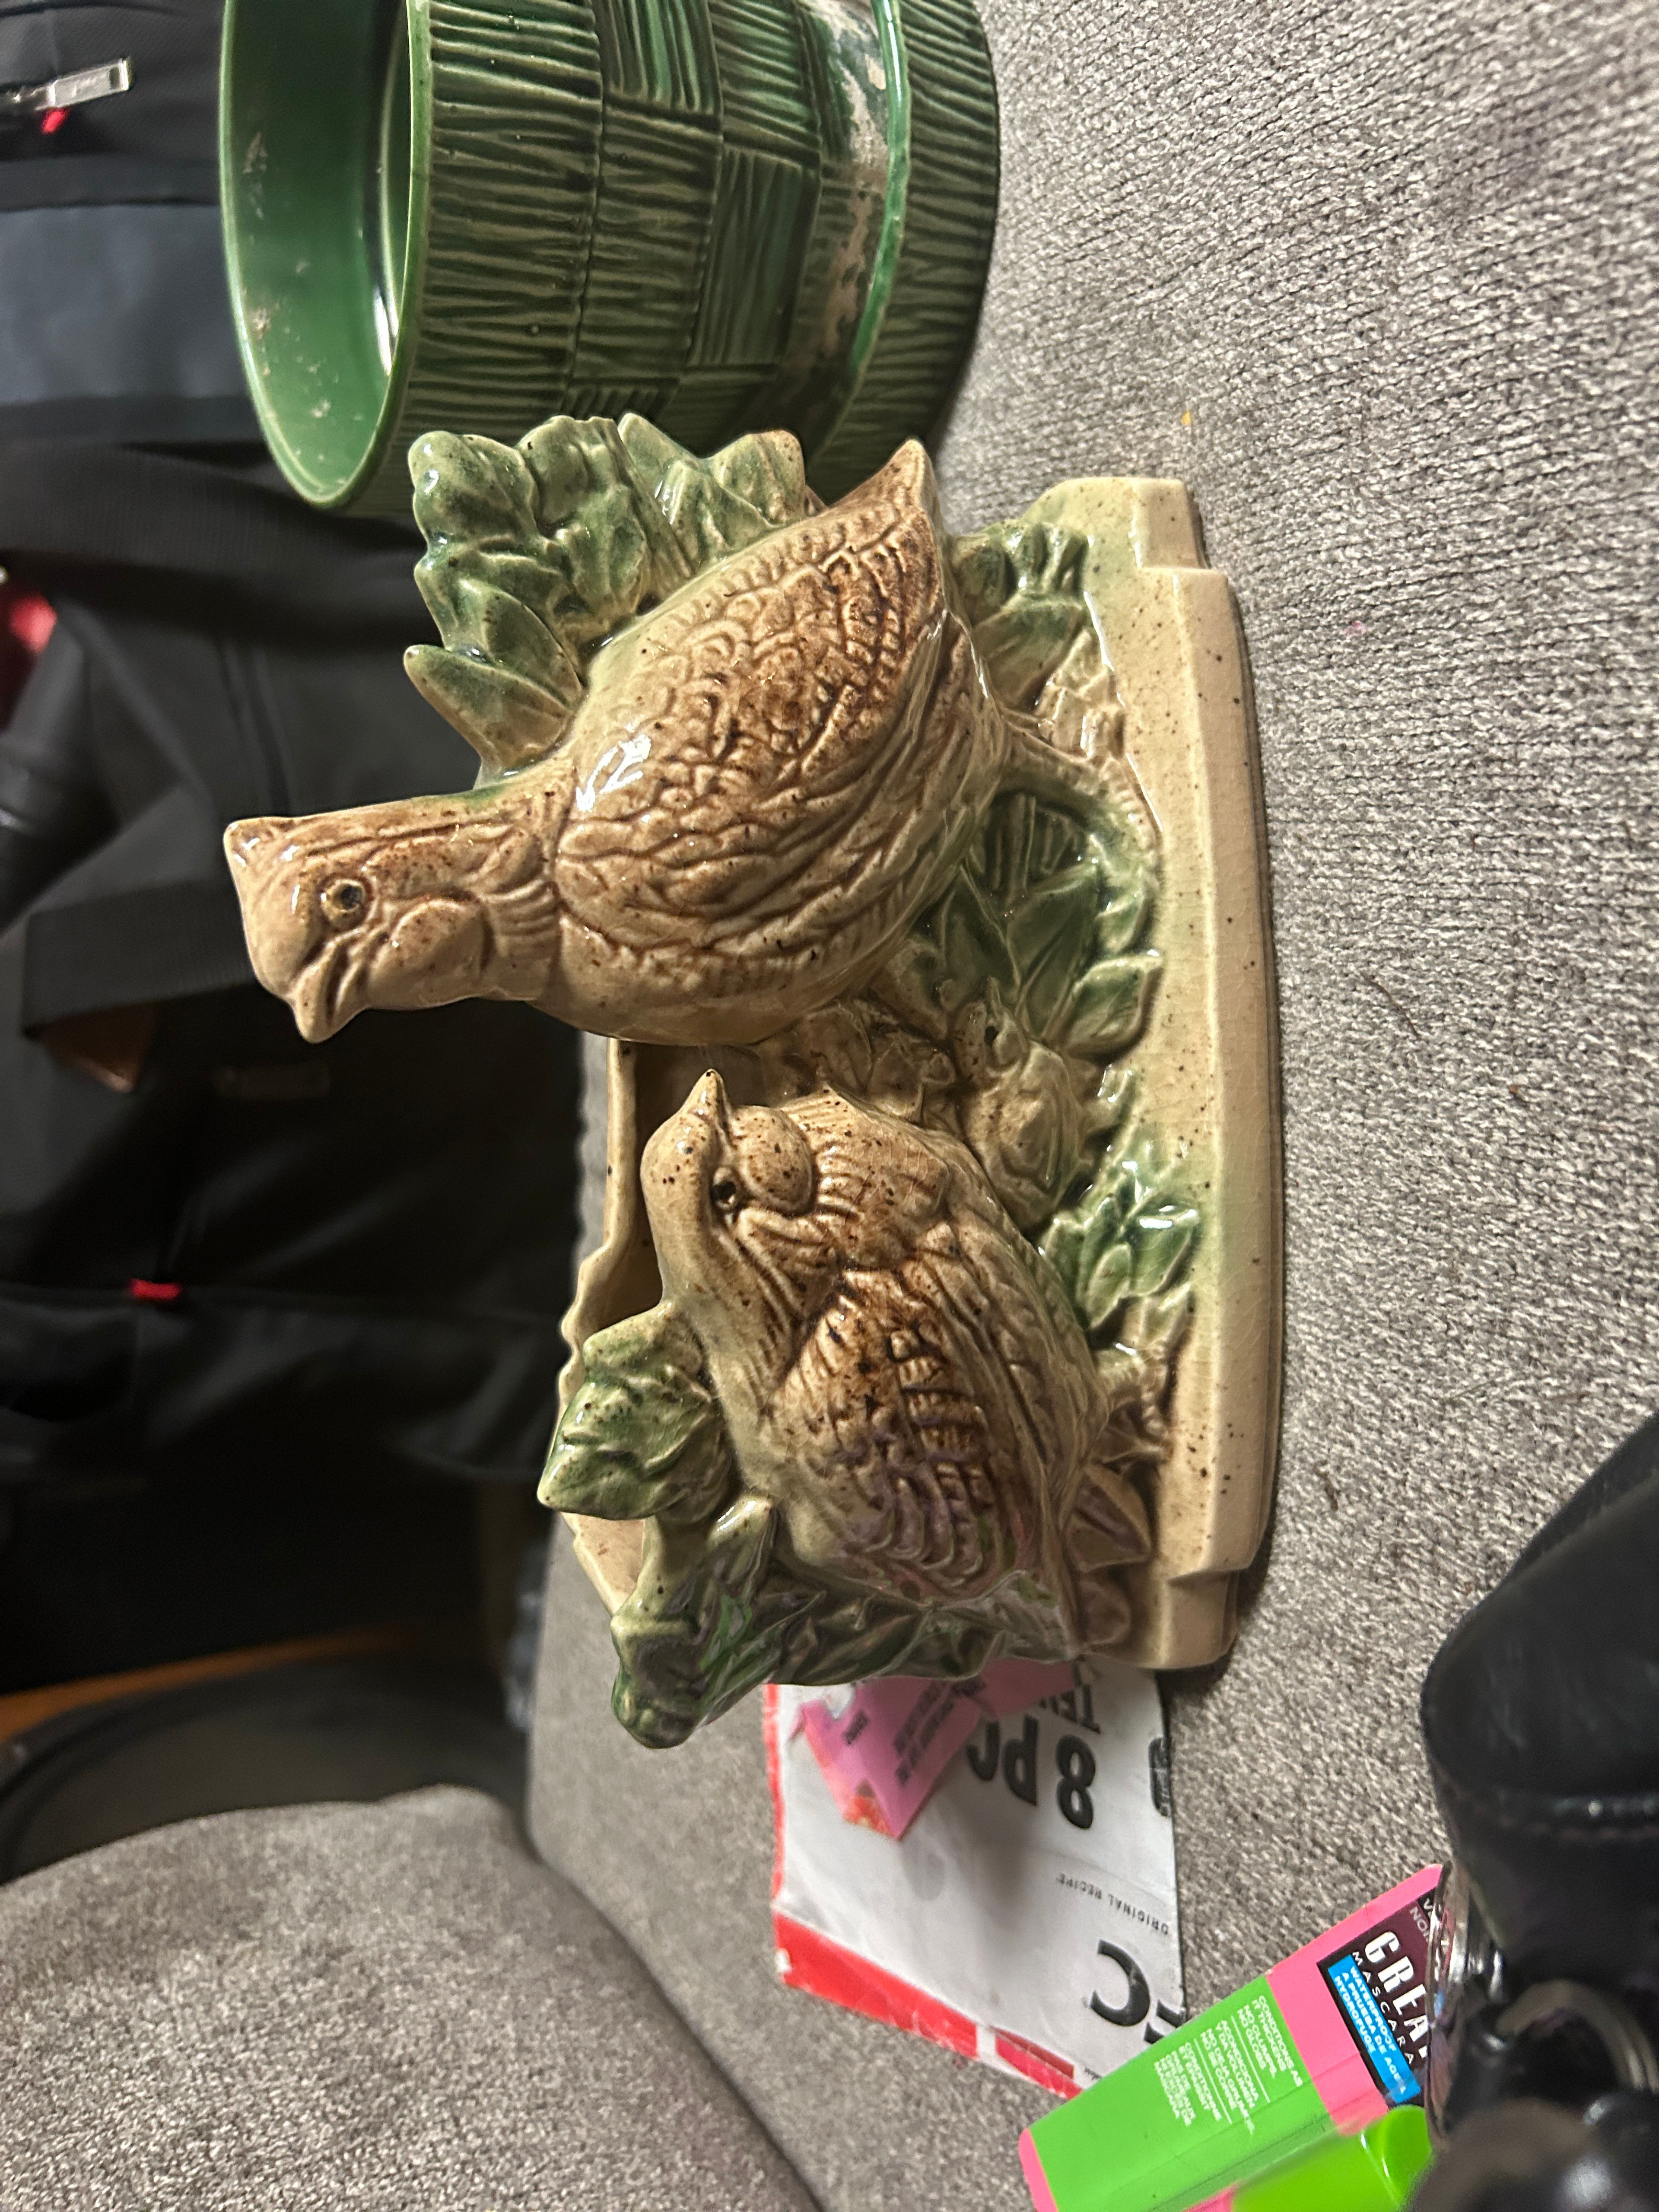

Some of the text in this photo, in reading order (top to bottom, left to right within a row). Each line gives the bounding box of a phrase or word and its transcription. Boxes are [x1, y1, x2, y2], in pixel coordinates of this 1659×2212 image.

[1055, 1735, 1096, 1829] 8
[1056, 1873, 1169, 1935] ORIGINAL RECIPE
[1201, 2032, 1211, 2050] NO
[1238, 2009, 1249, 2028] NO
[1244, 2005, 1255, 2024] NO
[1252, 1999, 1287, 2071] IT THICKENS
[1258, 1996, 1303, 2087] CONDITIONS AS
[1335, 1976, 1375, 2053] HYDROFUGE
[1348, 1983, 1376, 2034] PRUEBA
[1375, 2035, 1386, 2053] DE
[1351, 1967, 1396, 2050] WATERPROOF
[1353, 1952, 1414, 2064] MASCARA
[1207, 2028, 1217, 2047] NO
[1214, 2047, 1230, 2079] DEJA
[1219, 2032, 1229, 2050] DA
[1227, 2050, 1255, 2108] VOLUMEN
[1220, 2021, 1259, 2101] ACONDICIONA
